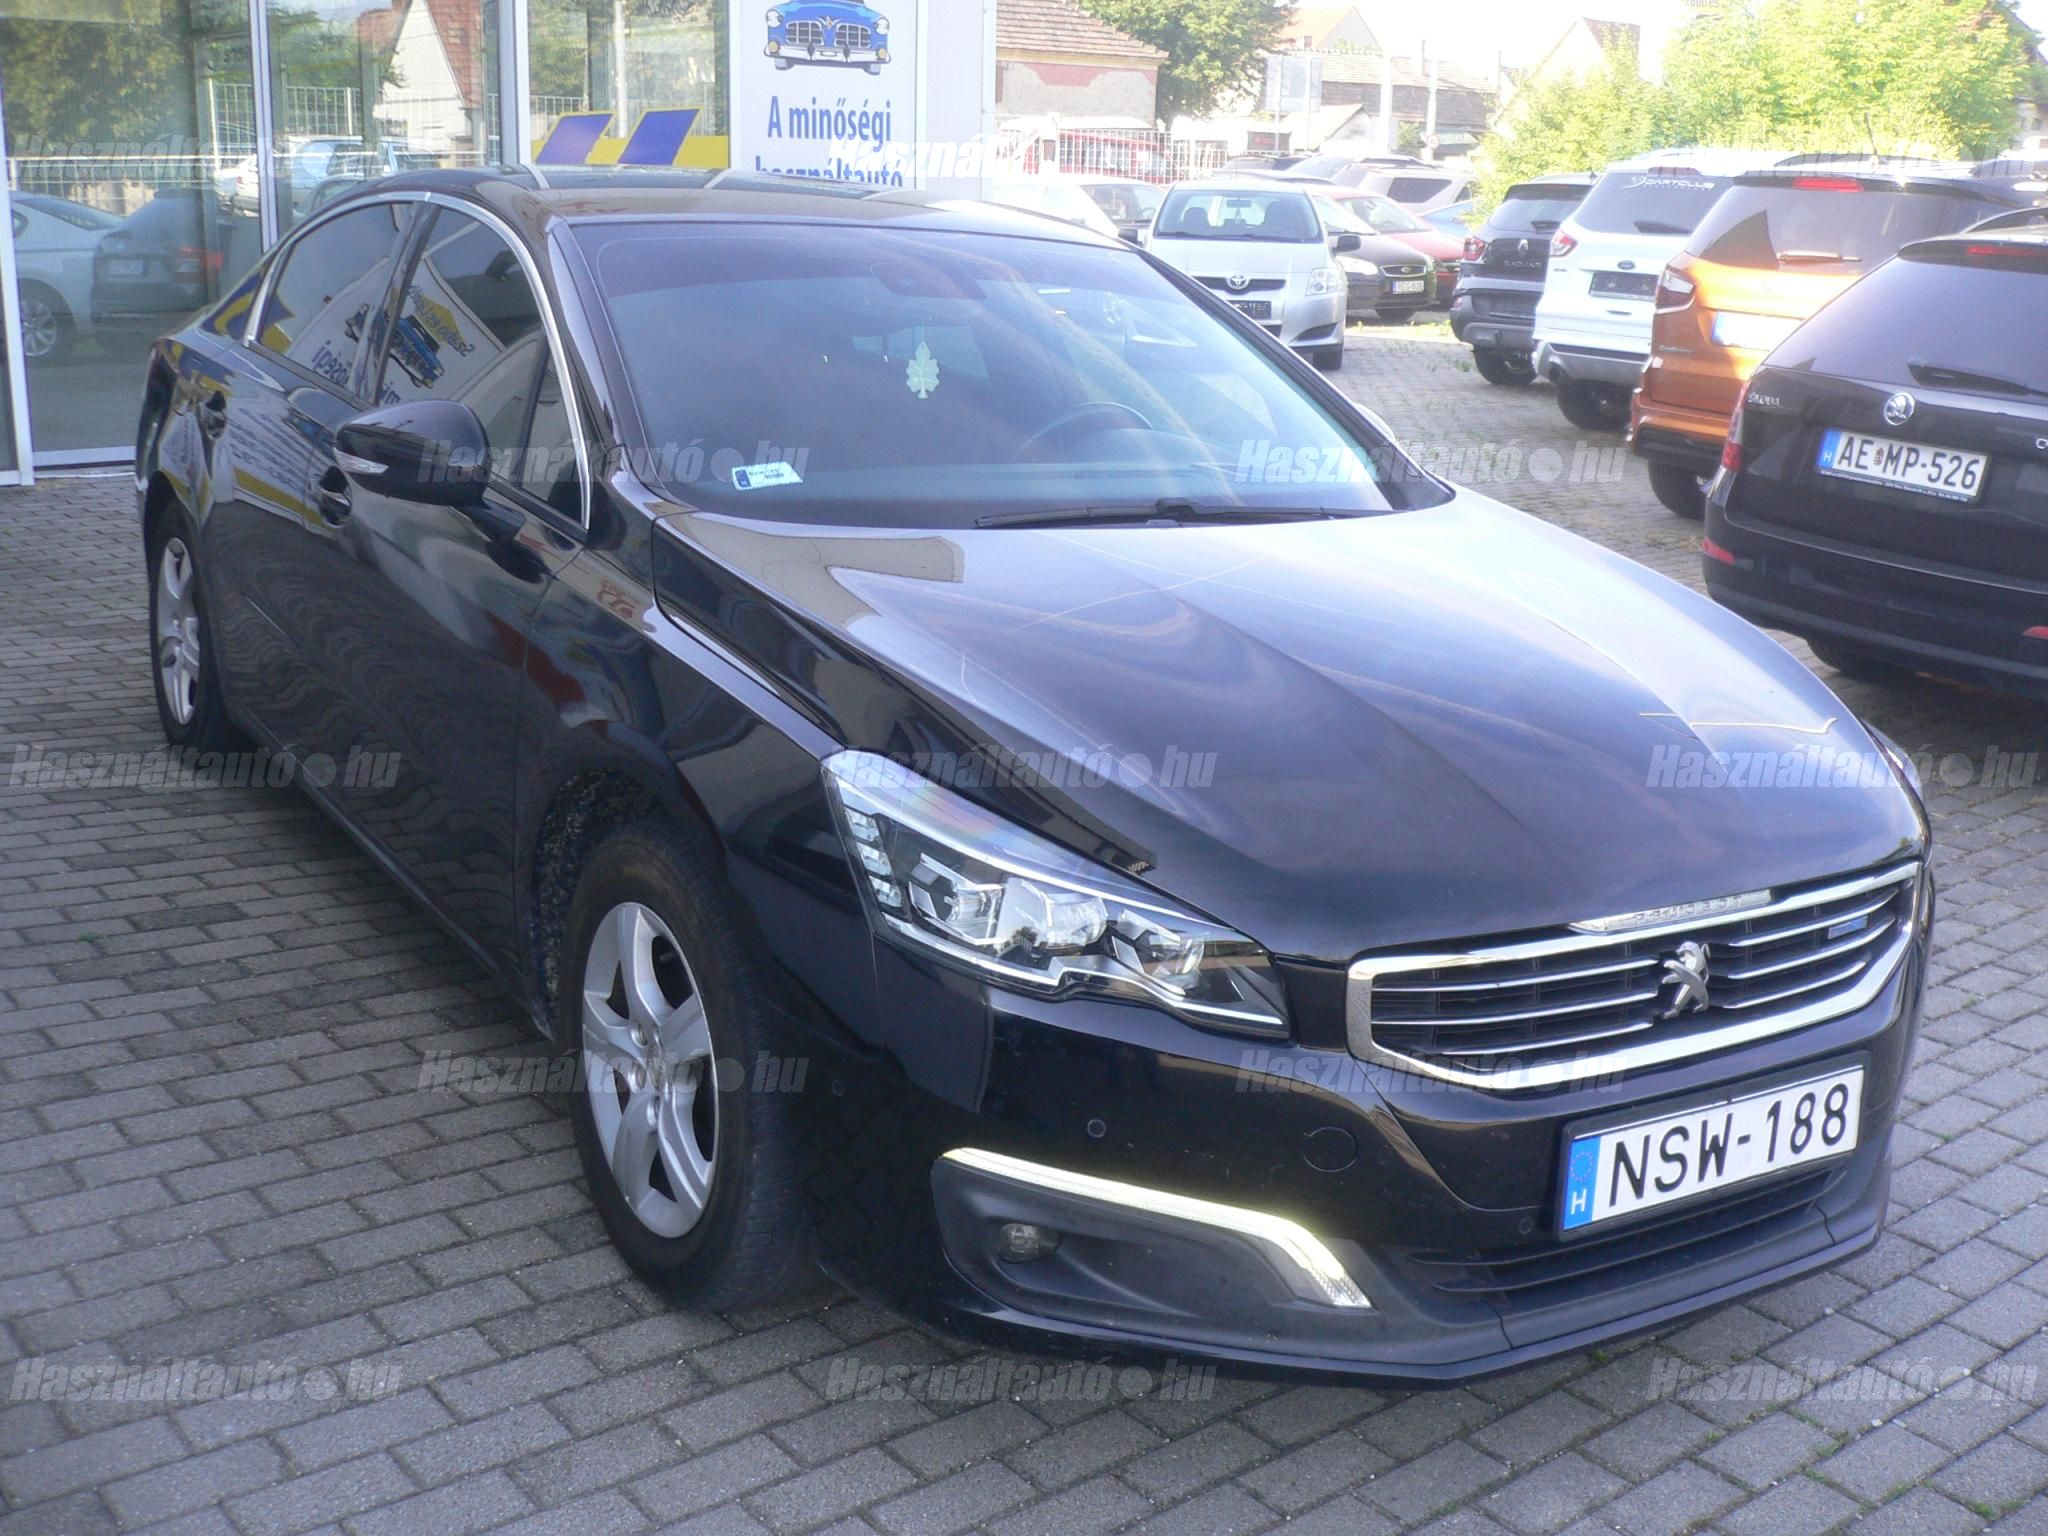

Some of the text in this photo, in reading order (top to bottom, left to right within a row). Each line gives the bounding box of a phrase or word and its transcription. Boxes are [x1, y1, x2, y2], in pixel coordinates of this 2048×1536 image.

[767, 95, 892, 153] A minőségi
[1837, 436, 1875, 470] AE
[1882, 443, 1980, 490] MP-526
[1570, 1083, 1849, 1215] H NSW-188
